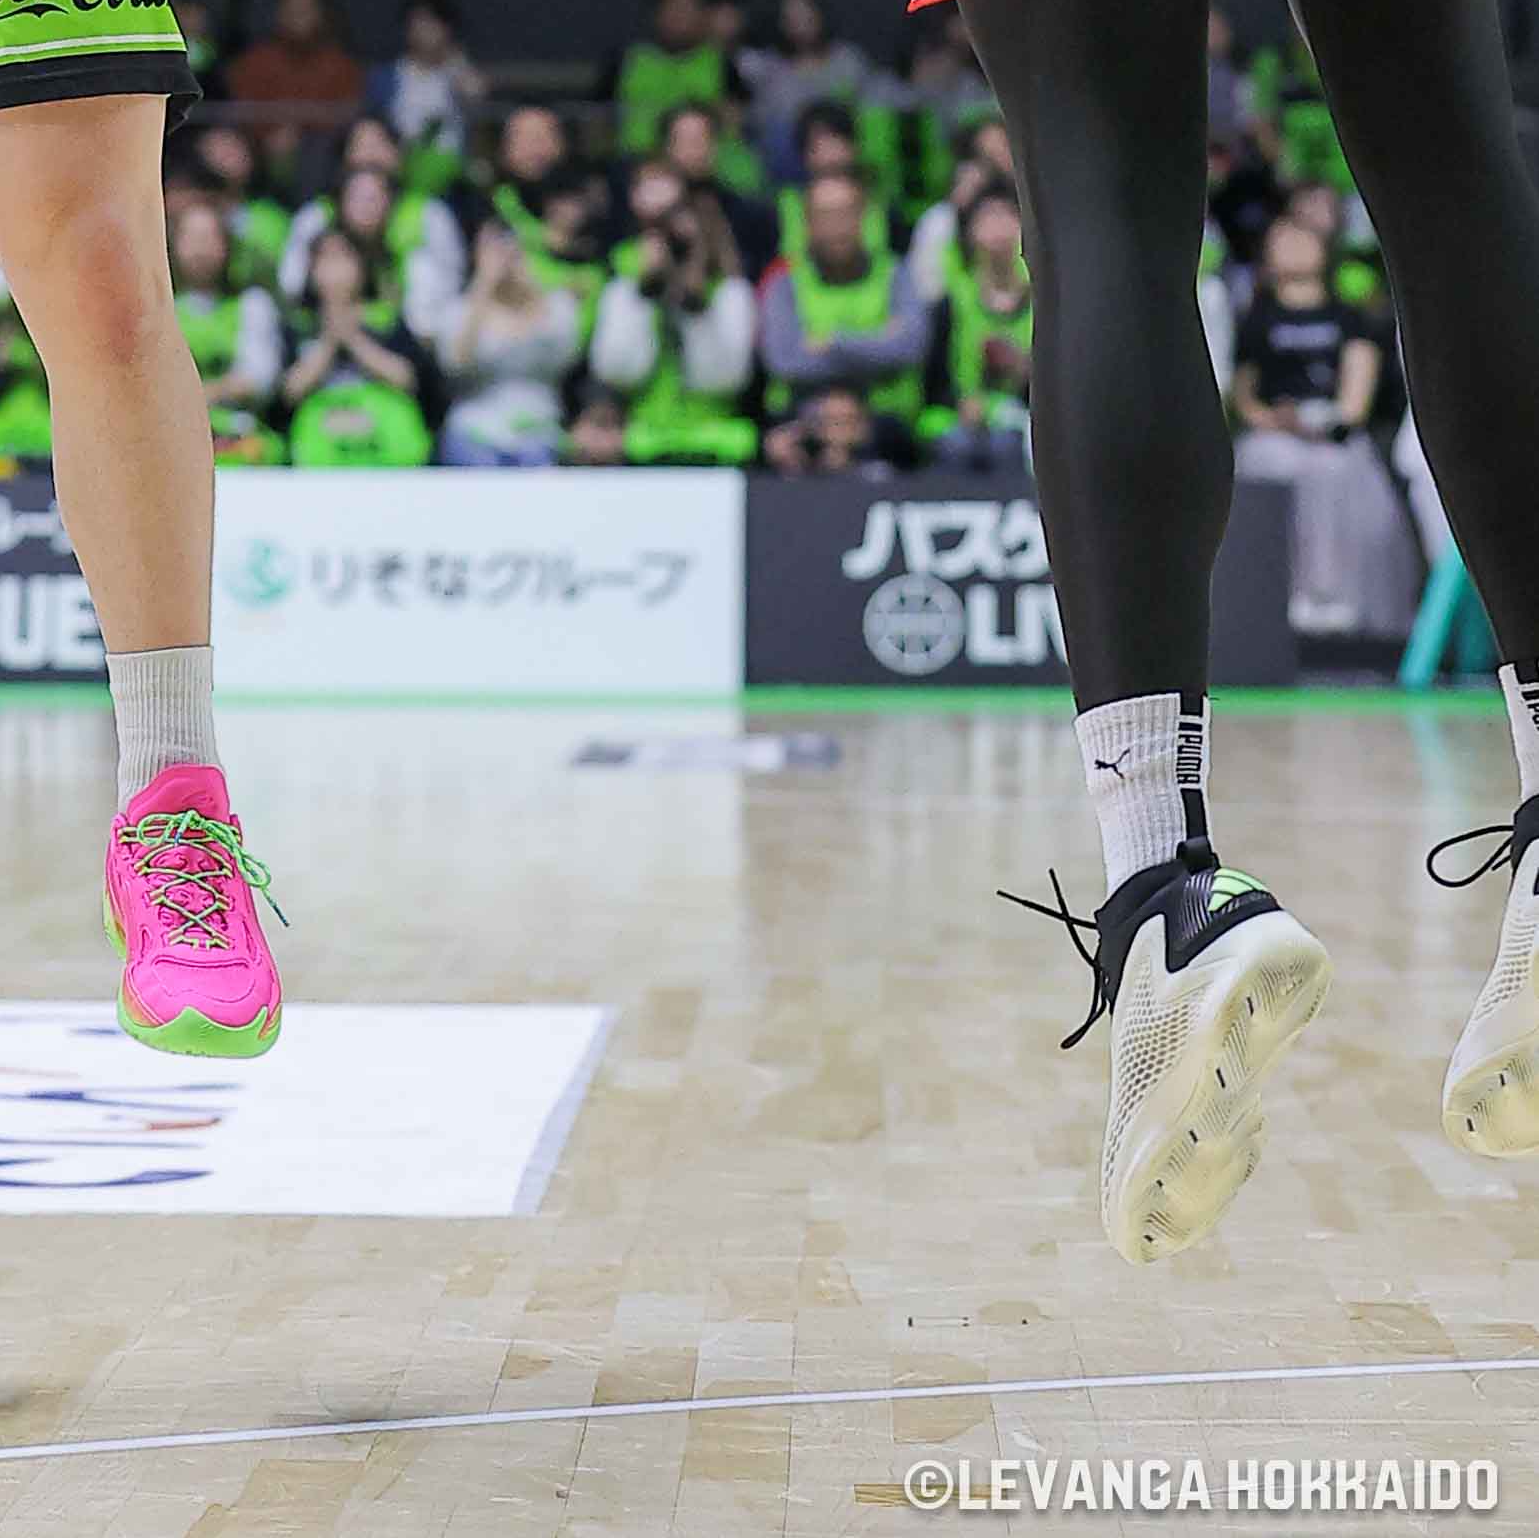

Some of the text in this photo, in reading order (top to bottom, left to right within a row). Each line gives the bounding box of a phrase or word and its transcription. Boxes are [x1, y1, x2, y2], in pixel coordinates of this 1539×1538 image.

[307, 545, 698, 608] りそなグループ
[1176, 734, 1203, 784] PUMA
